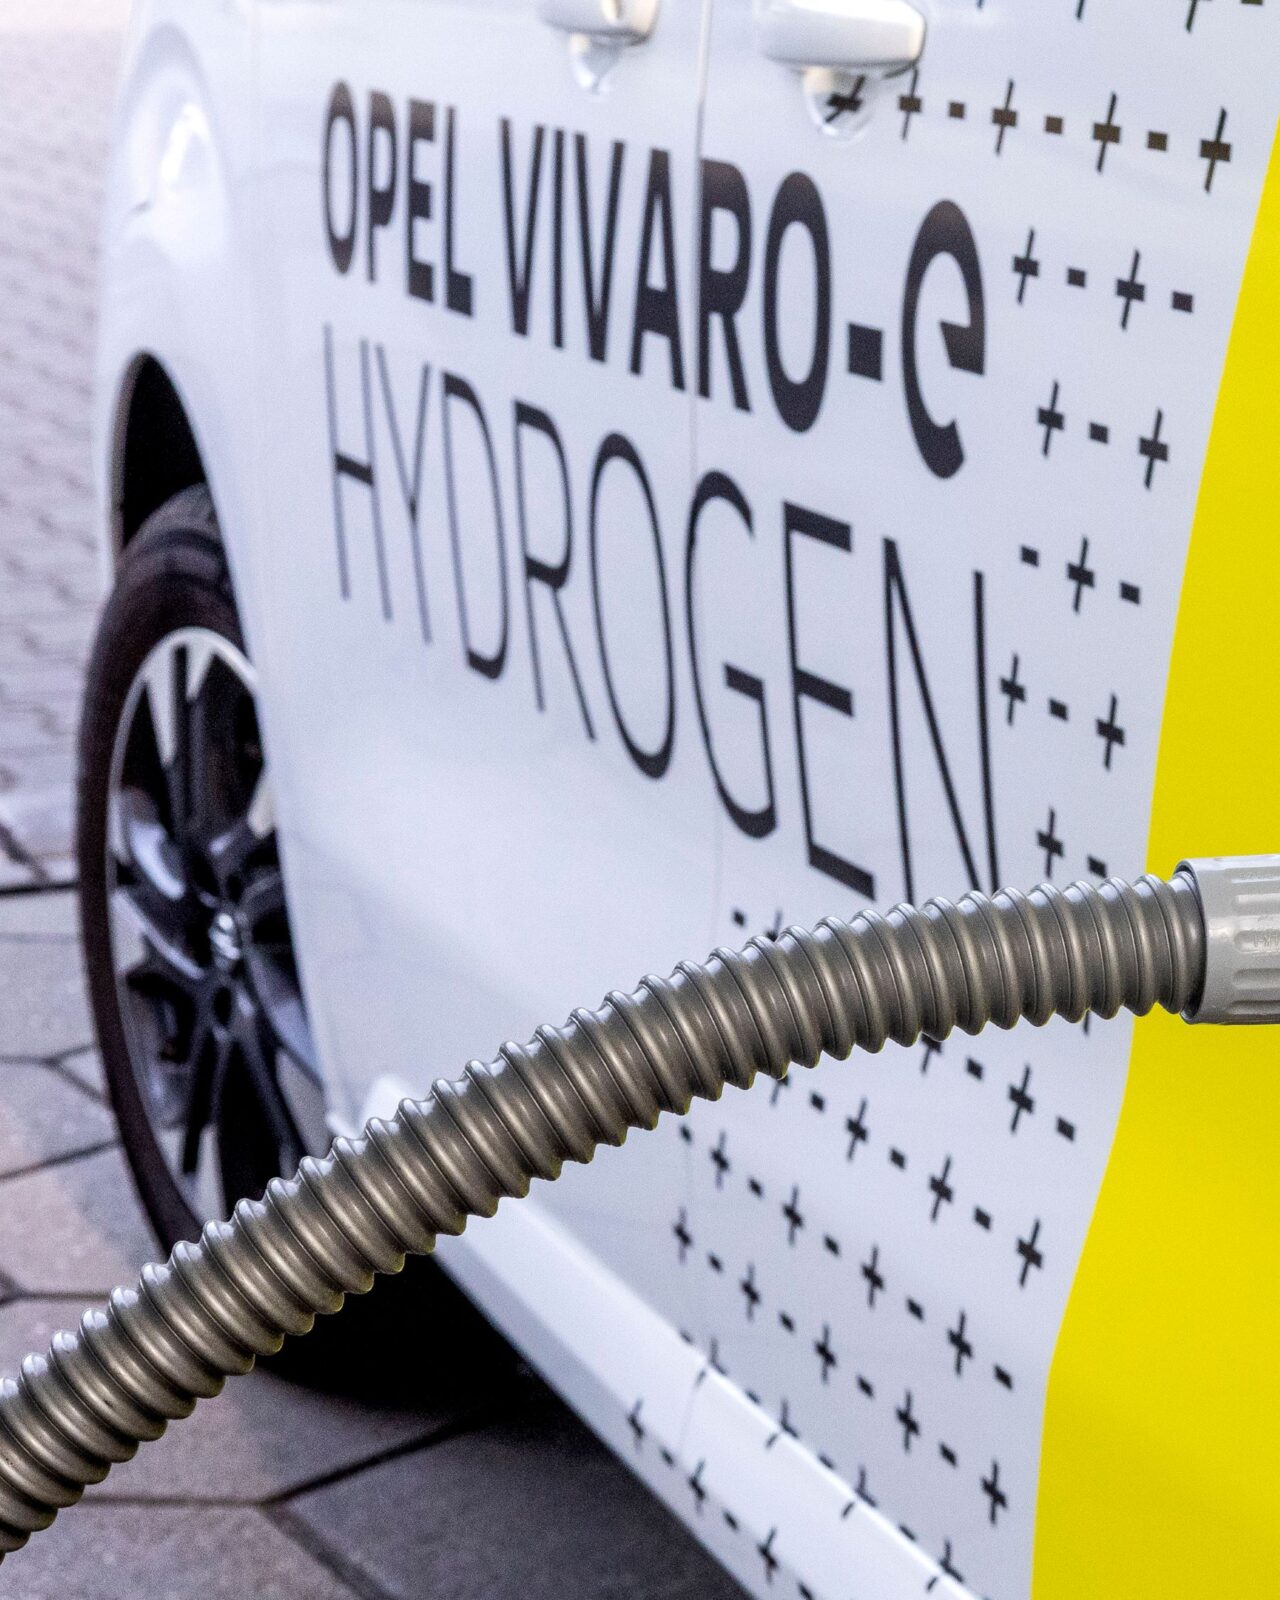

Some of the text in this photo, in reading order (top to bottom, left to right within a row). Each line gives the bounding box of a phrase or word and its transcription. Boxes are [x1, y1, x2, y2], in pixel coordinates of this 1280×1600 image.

[322, 78, 986, 480] OPEL VIVARO-e
[323, 322, 999, 906] HYDROGEN
